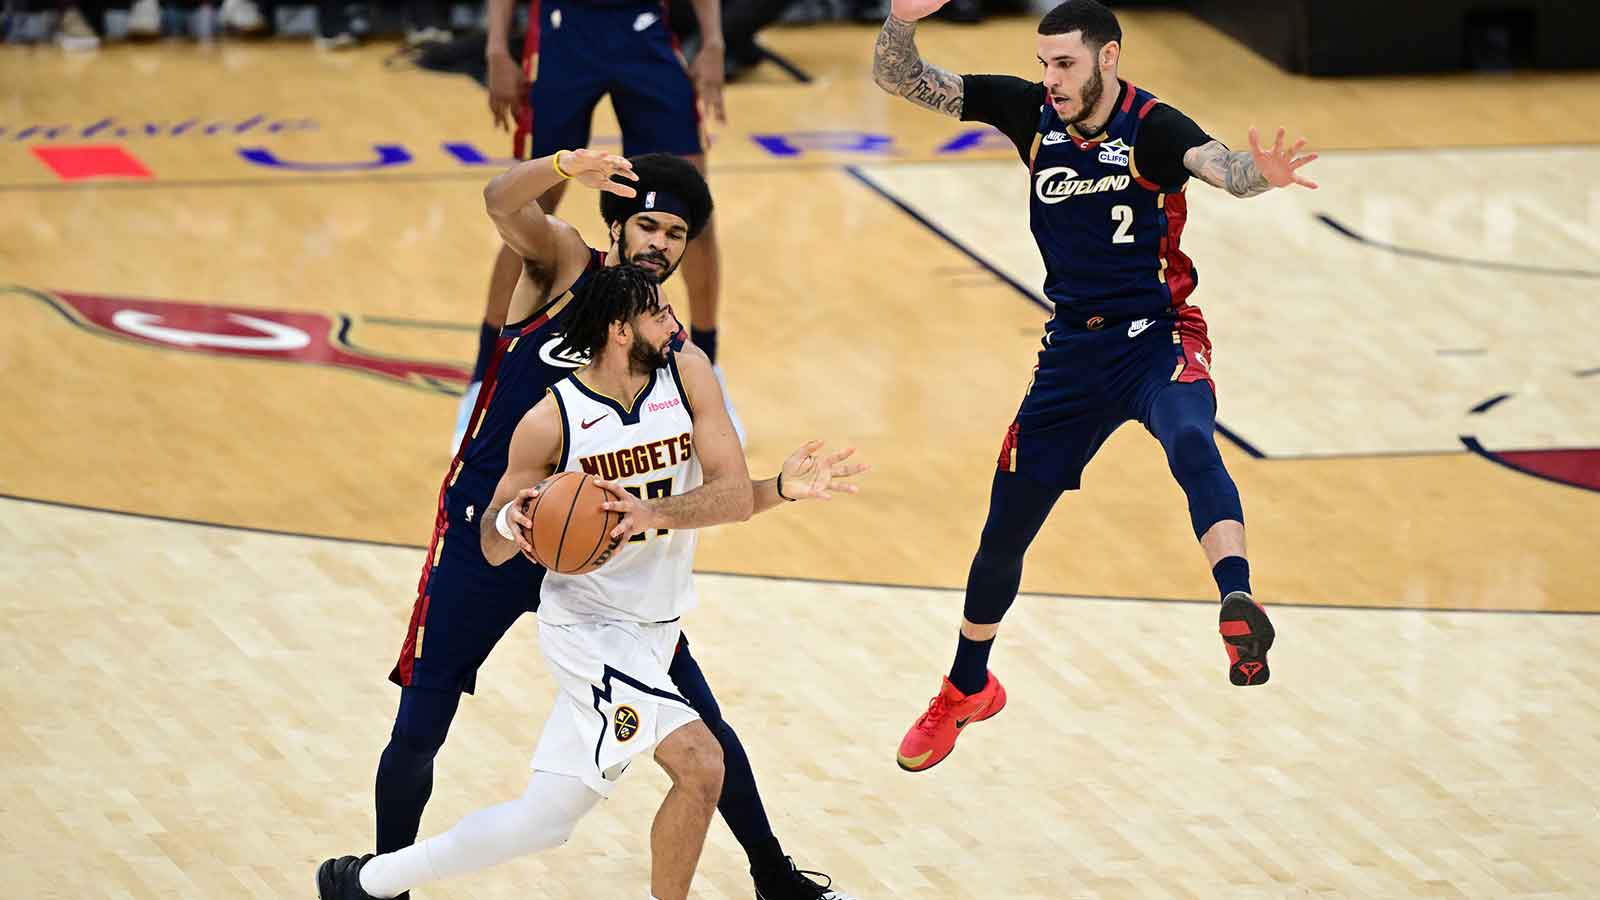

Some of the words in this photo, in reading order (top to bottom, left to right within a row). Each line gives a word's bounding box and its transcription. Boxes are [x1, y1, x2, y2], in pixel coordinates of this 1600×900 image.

[1099, 152, 1128, 165] CLIFFS
[1035, 166, 1130, 204] CLEVELAND
[1111, 204, 1135, 244] 2
[647, 398, 680, 412] ibotta
[579, 432, 692, 481] NUGGETS
